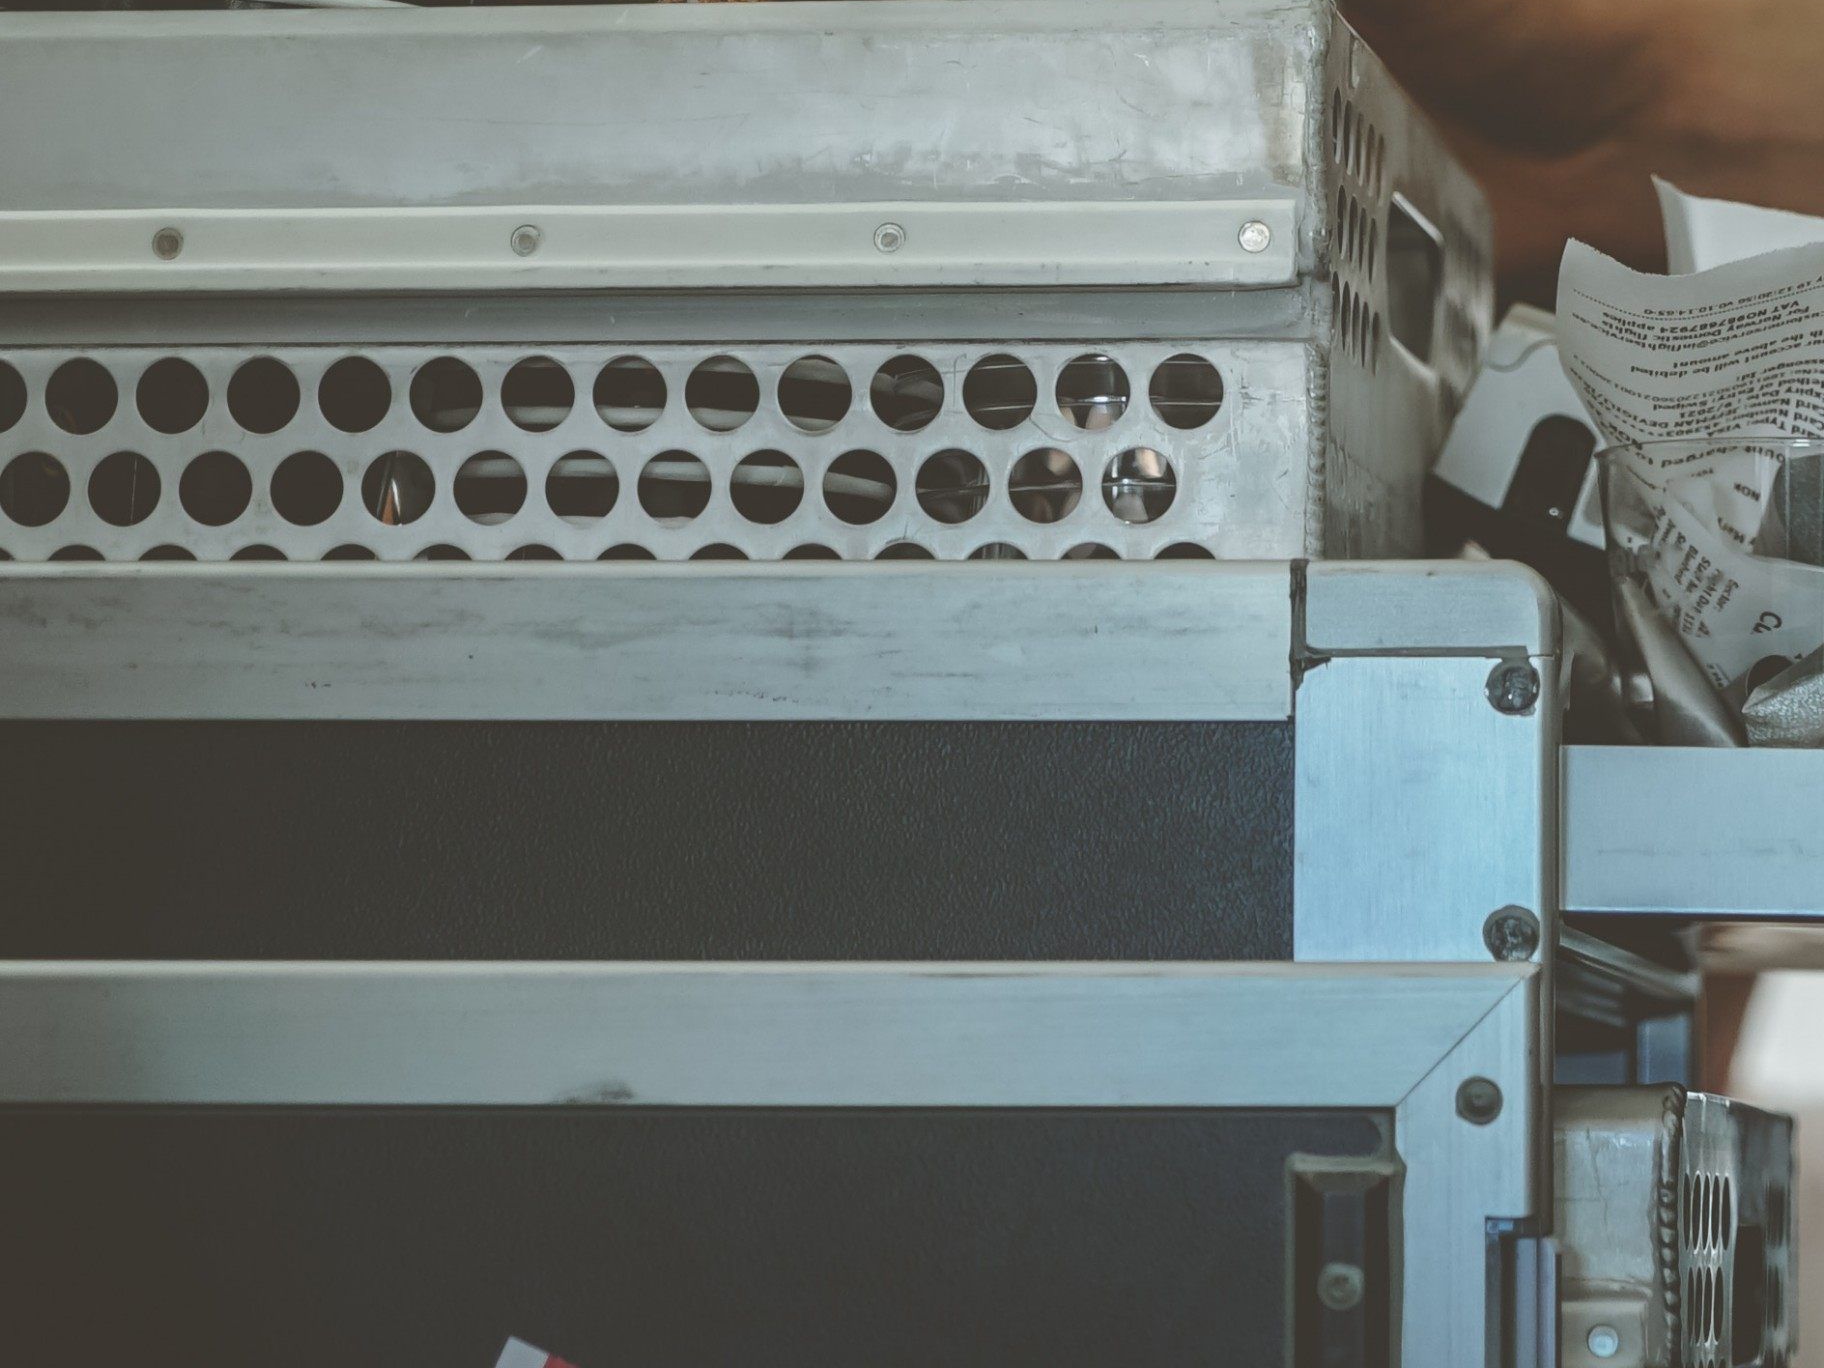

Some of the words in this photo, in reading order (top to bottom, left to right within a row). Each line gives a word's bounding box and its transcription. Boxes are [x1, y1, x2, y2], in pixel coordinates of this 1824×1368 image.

[1772, 300, 1800, 313] VAT
[1788, 306, 1810, 317] For
[1602, 312, 1655, 330] applies
[1727, 313, 1782, 332] Norway
[1602, 320, 1648, 340] flights
[1653, 328, 1721, 342] Domestic
[1781, 332, 1804, 343] the
[1734, 339, 1777, 356] above
[1745, 342, 1801, 364] account
[1673, 352, 1729, 368] amount
[1715, 359, 1740, 372] will
[1630, 365, 1688, 378] debited
[1760, 382, 1773, 391] of
[1793, 412, 1824, 431] Card
